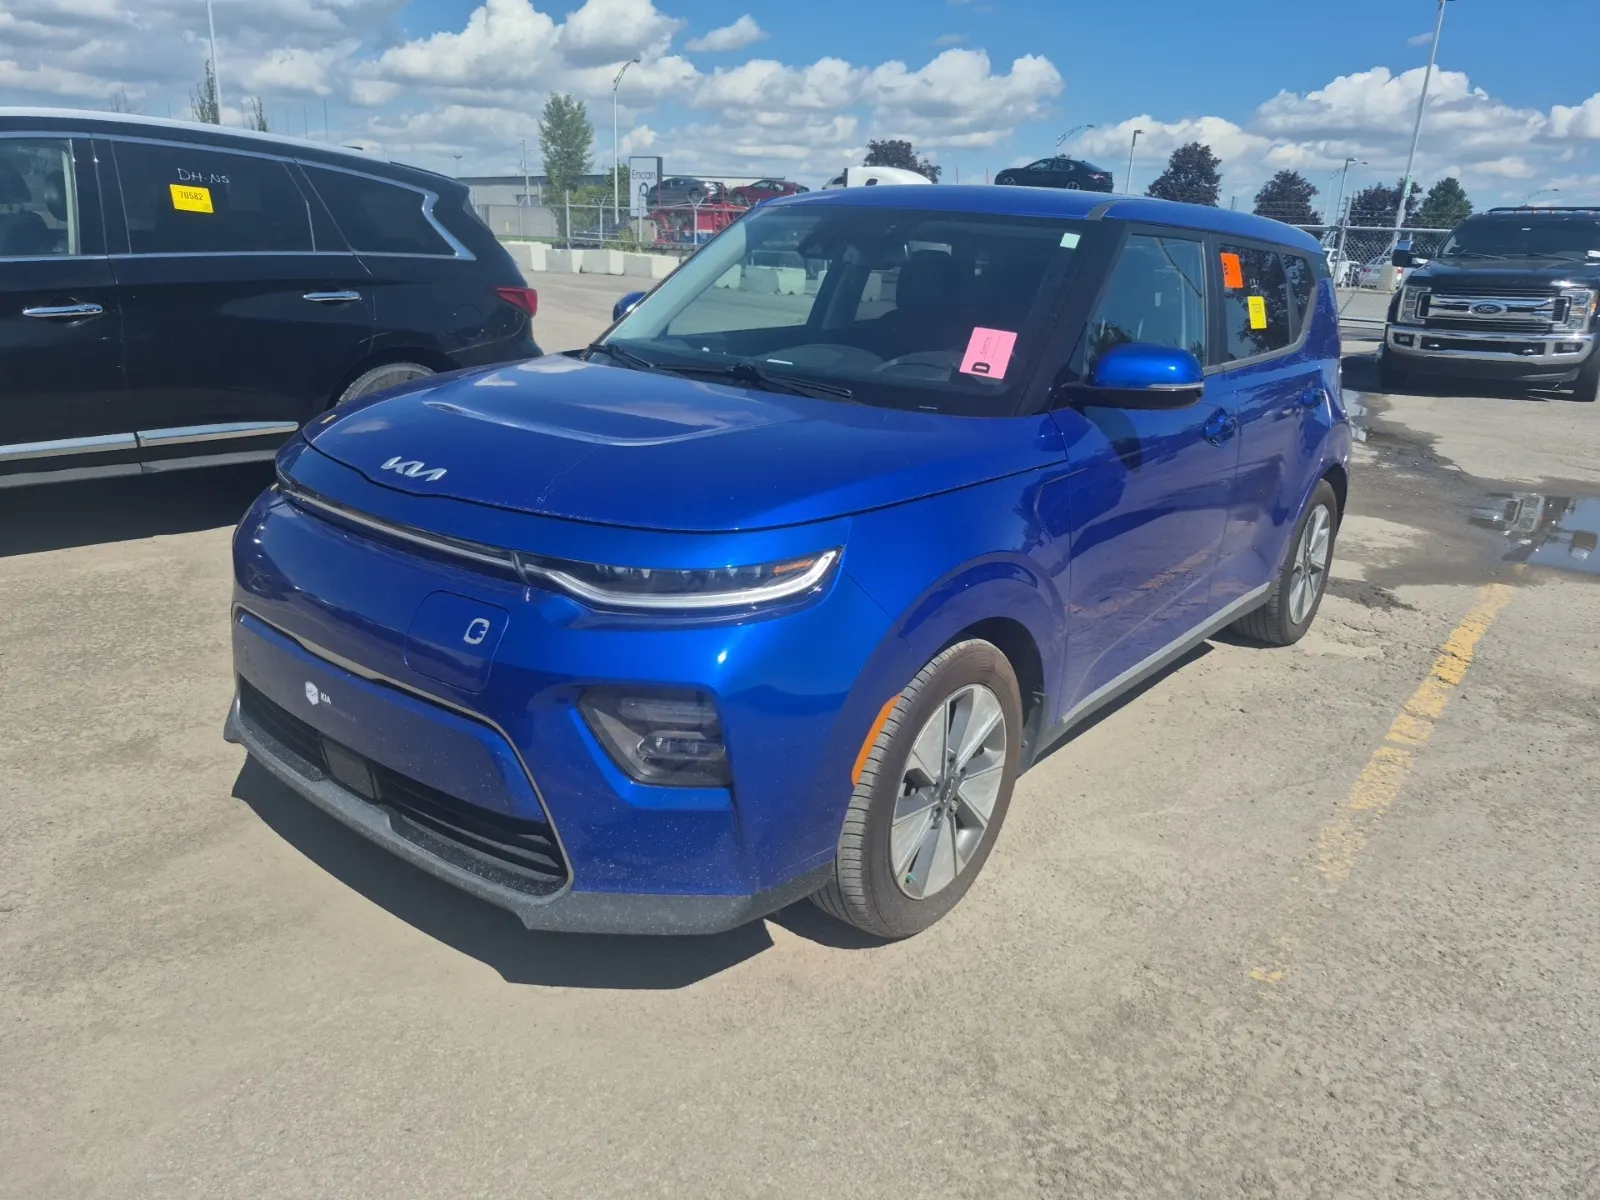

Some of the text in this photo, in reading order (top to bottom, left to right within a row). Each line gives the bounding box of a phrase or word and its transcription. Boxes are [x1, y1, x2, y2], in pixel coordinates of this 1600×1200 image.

[178, 190, 204, 201] 70582
[971, 361, 991, 374] D
[320, 691, 332, 705] KIA
